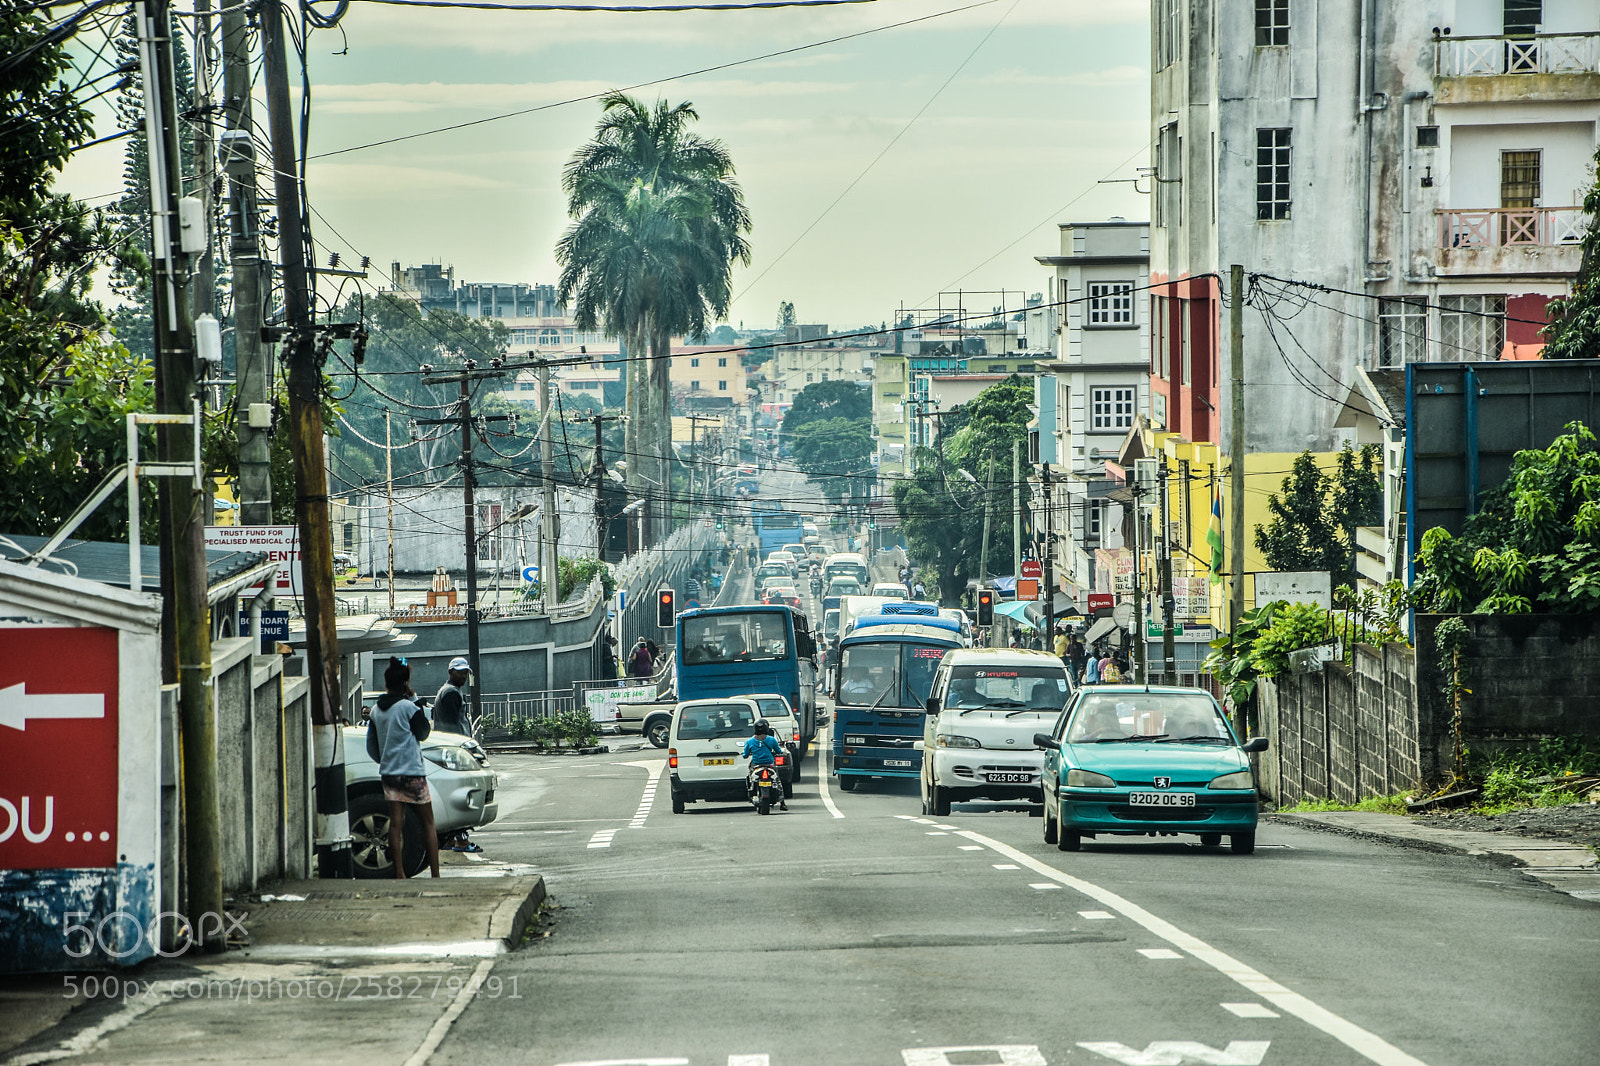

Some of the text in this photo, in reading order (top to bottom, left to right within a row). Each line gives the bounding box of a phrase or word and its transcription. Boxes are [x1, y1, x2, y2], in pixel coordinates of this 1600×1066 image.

[1007, 774, 1019, 782] DC
[1019, 774, 1029, 782] 98
[1131, 793, 1160, 805] 3202
[1180, 795, 1194, 806] 96
